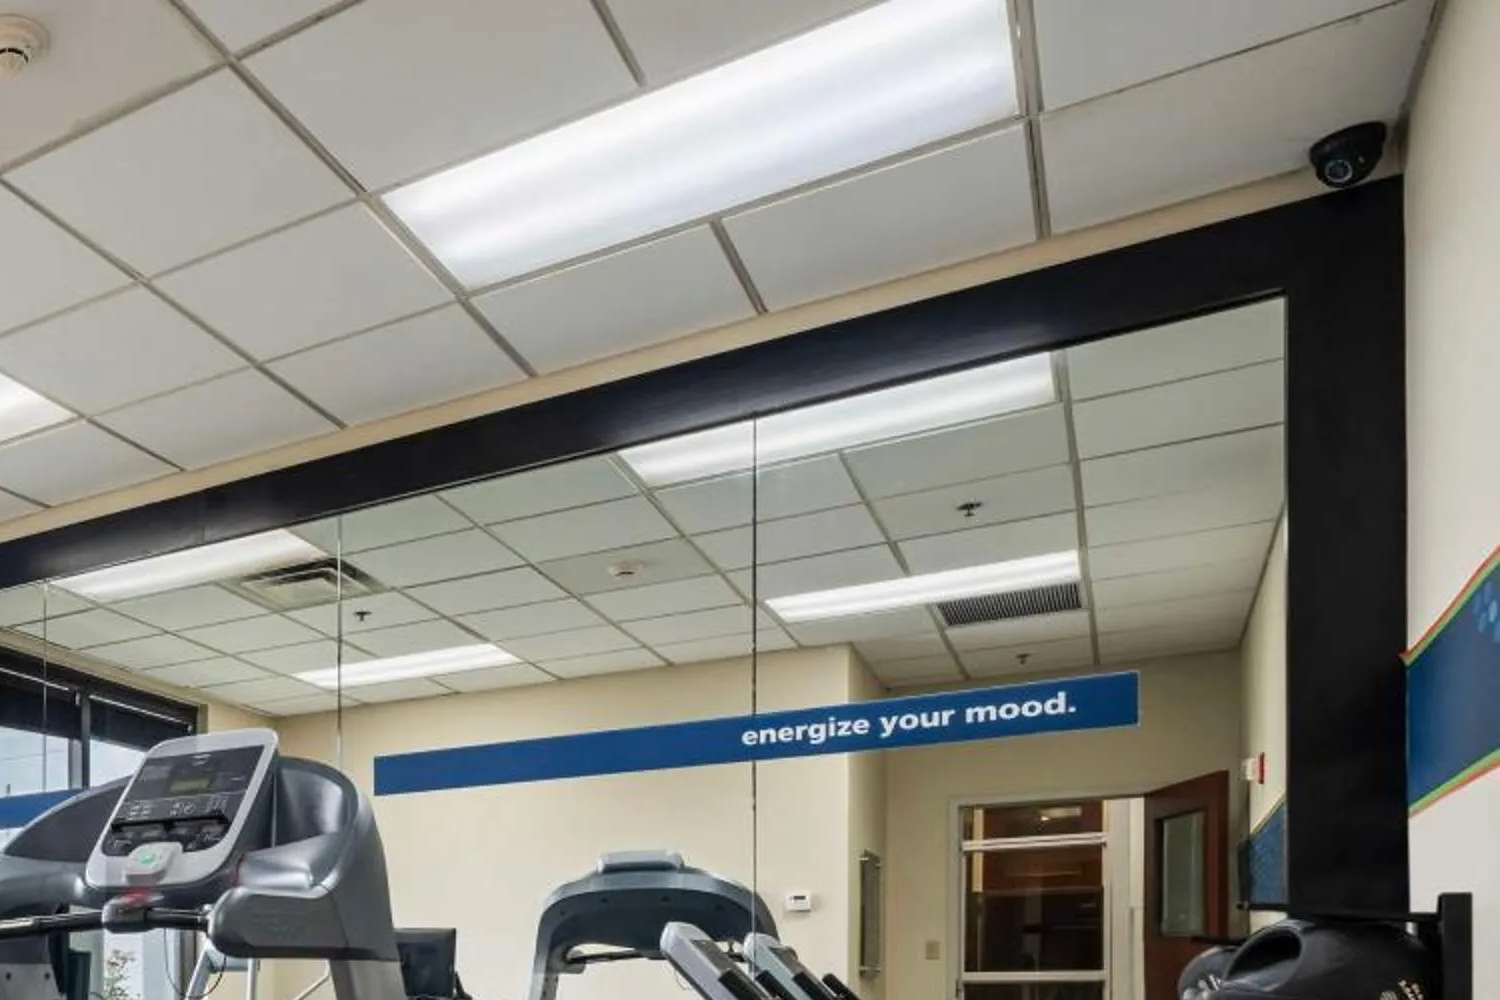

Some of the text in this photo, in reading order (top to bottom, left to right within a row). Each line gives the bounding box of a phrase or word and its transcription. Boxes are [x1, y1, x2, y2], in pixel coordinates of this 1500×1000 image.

[741, 691, 1077, 746] energize your mood.
